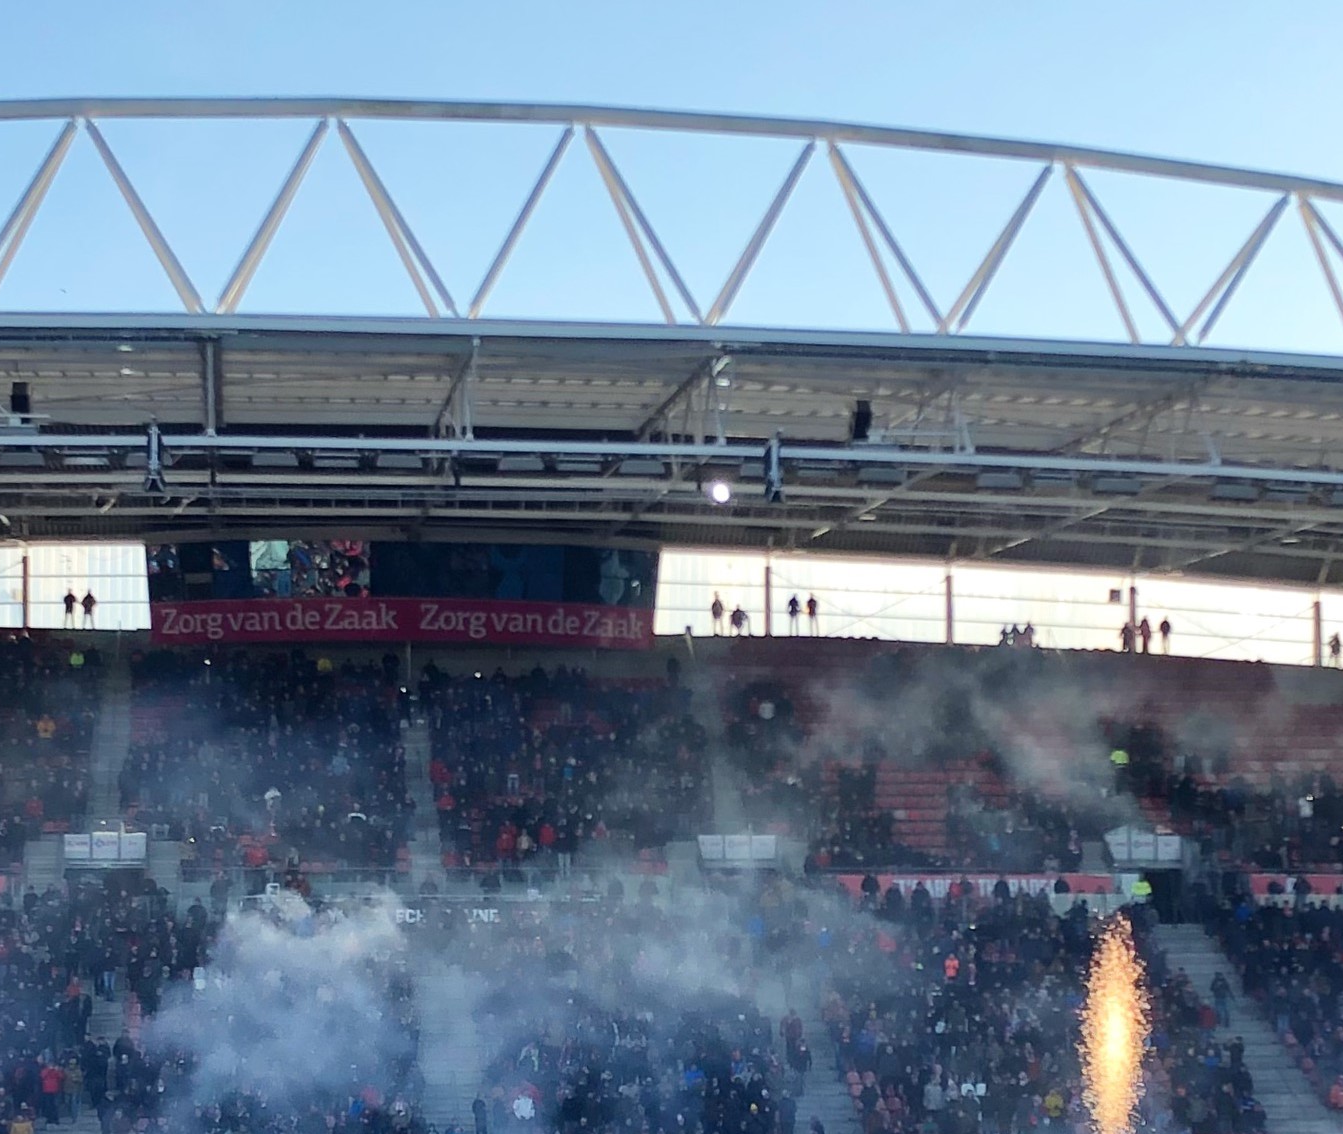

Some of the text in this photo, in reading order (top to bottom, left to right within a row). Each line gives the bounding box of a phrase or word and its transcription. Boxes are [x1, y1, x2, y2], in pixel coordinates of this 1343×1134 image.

[160, 603, 398, 639] Zorg van de Zaak
[420, 603, 643, 639] Zorg van de Zaak
